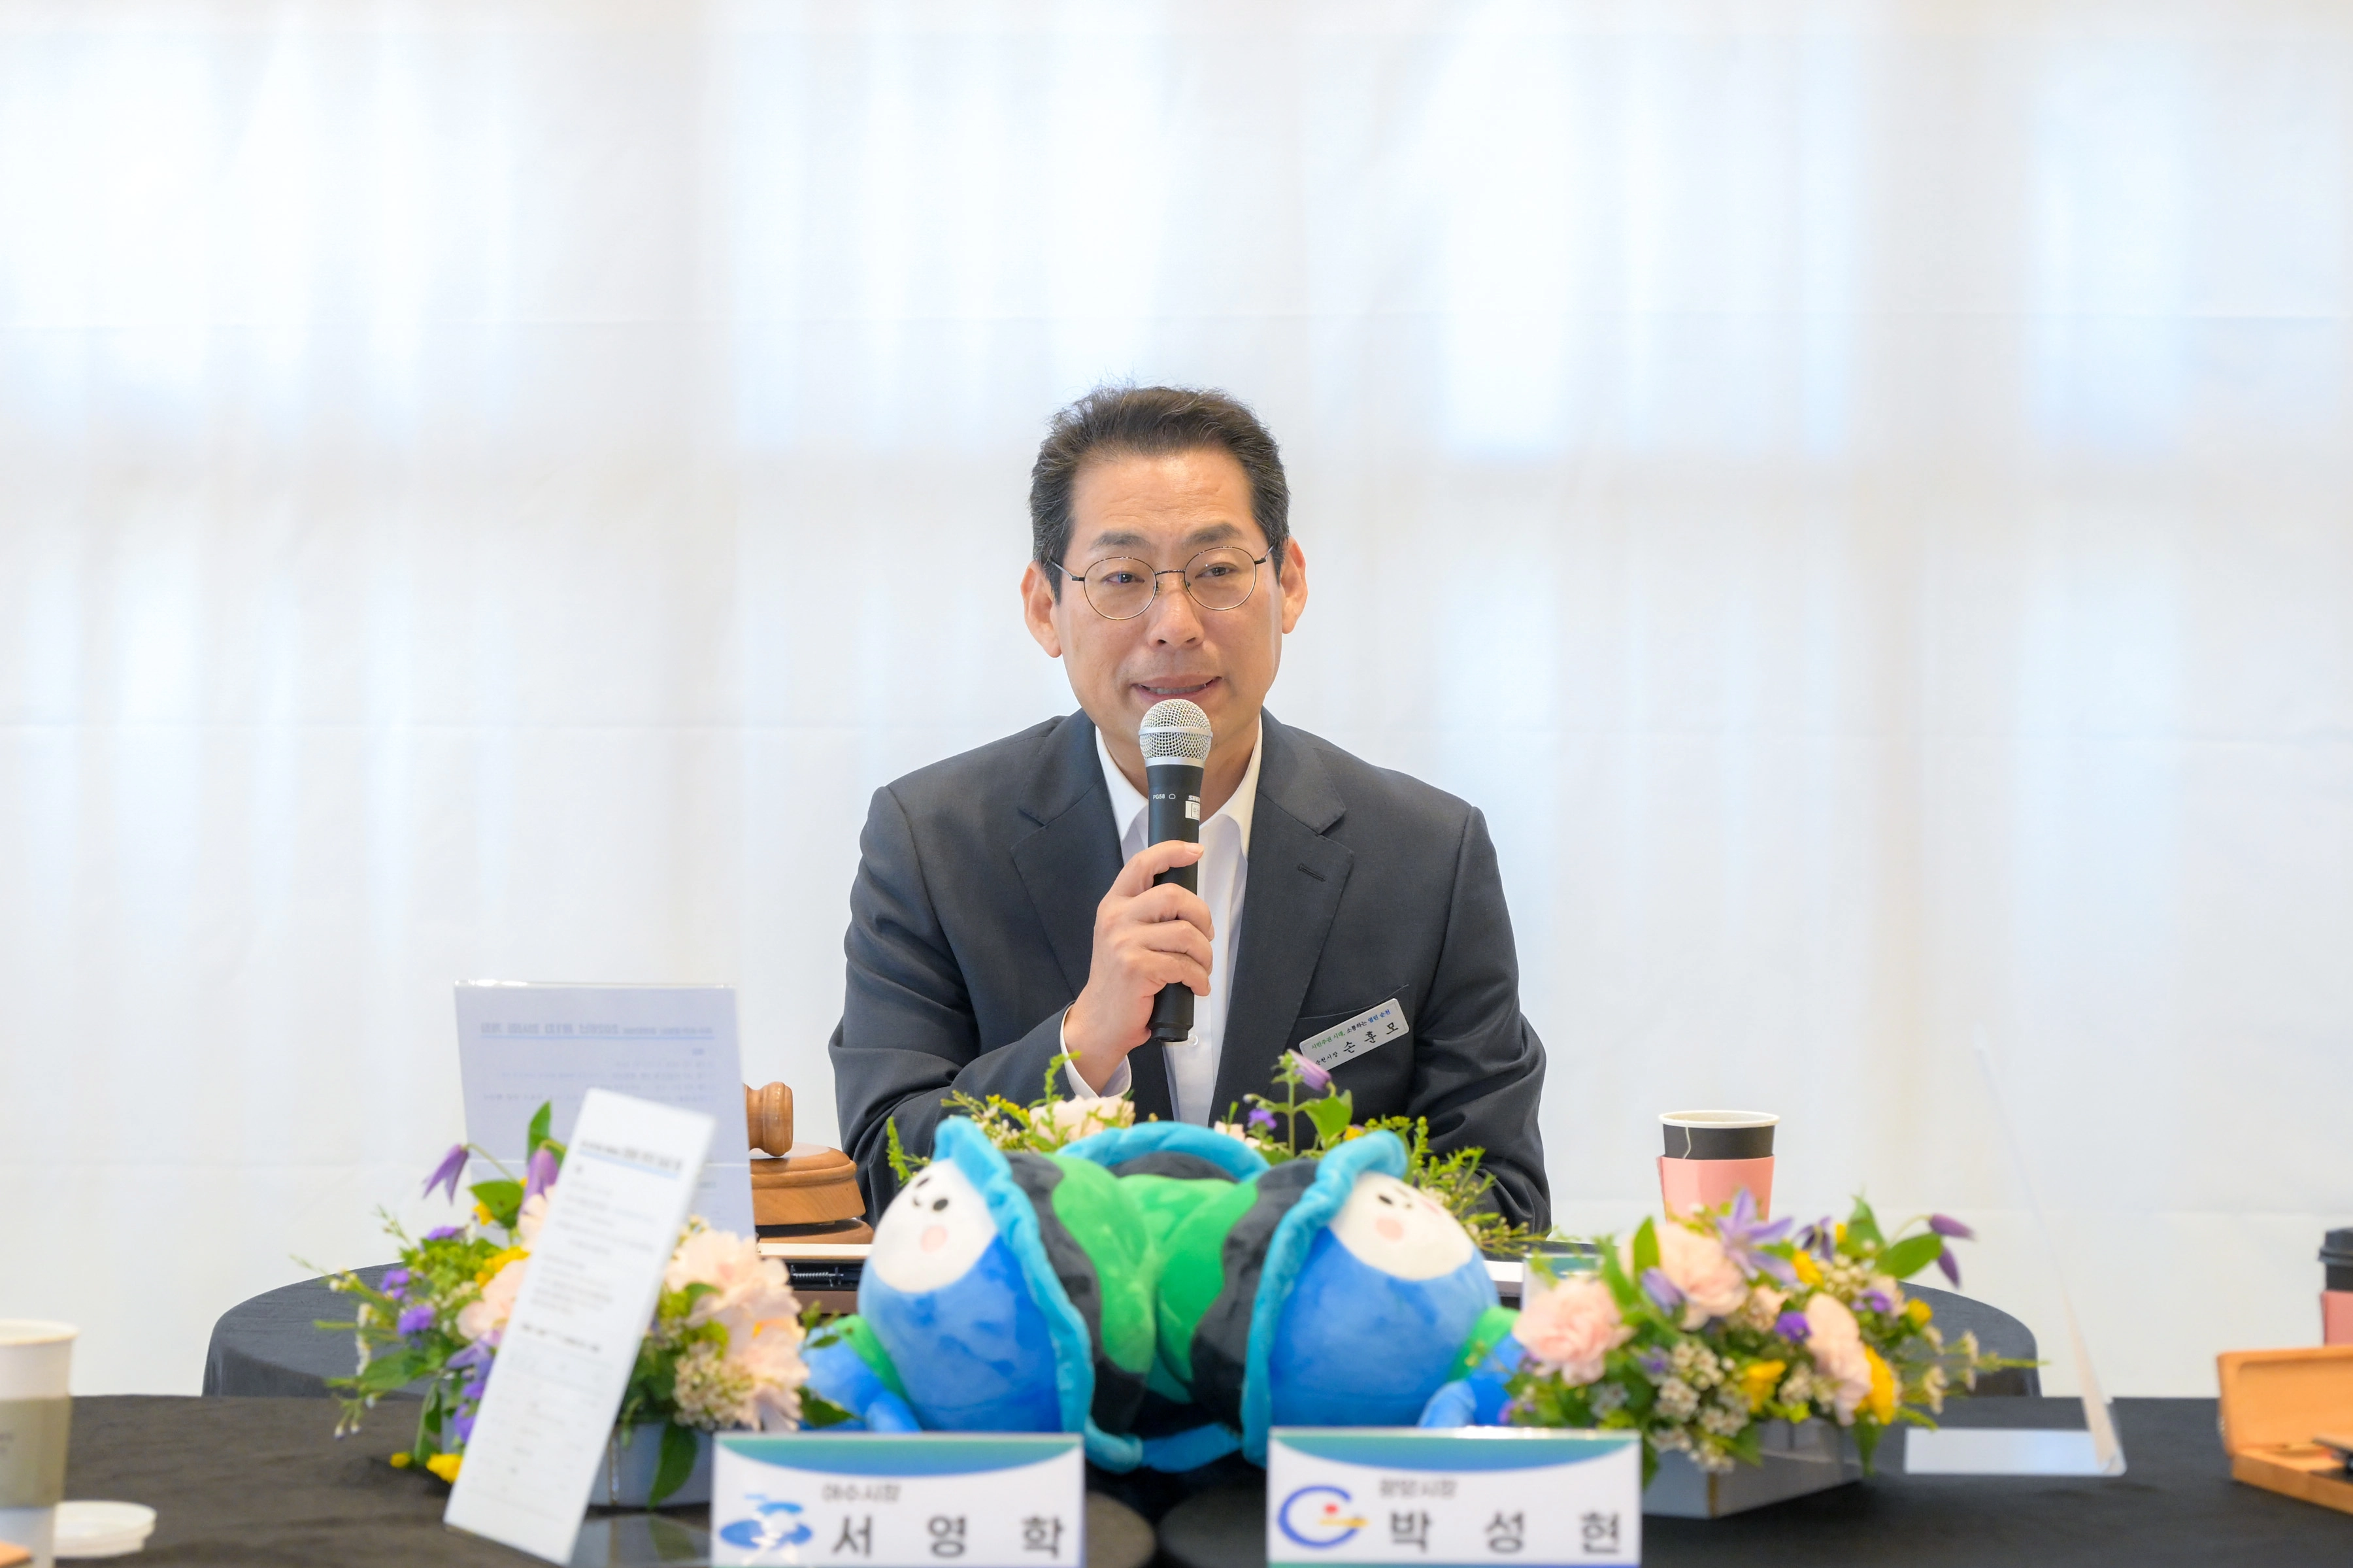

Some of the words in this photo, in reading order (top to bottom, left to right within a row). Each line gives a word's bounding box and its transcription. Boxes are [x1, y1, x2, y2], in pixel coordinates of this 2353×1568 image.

[1311, 1037, 1332, 1050] 시민주권
[1333, 1031, 1346, 1040] 시대,
[1346, 1021, 1367, 1033] 소통하는
[1368, 1014, 1378, 1024] 열린
[1380, 1009, 1391, 1018] 순천
[1315, 1051, 1339, 1065] 순천시장
